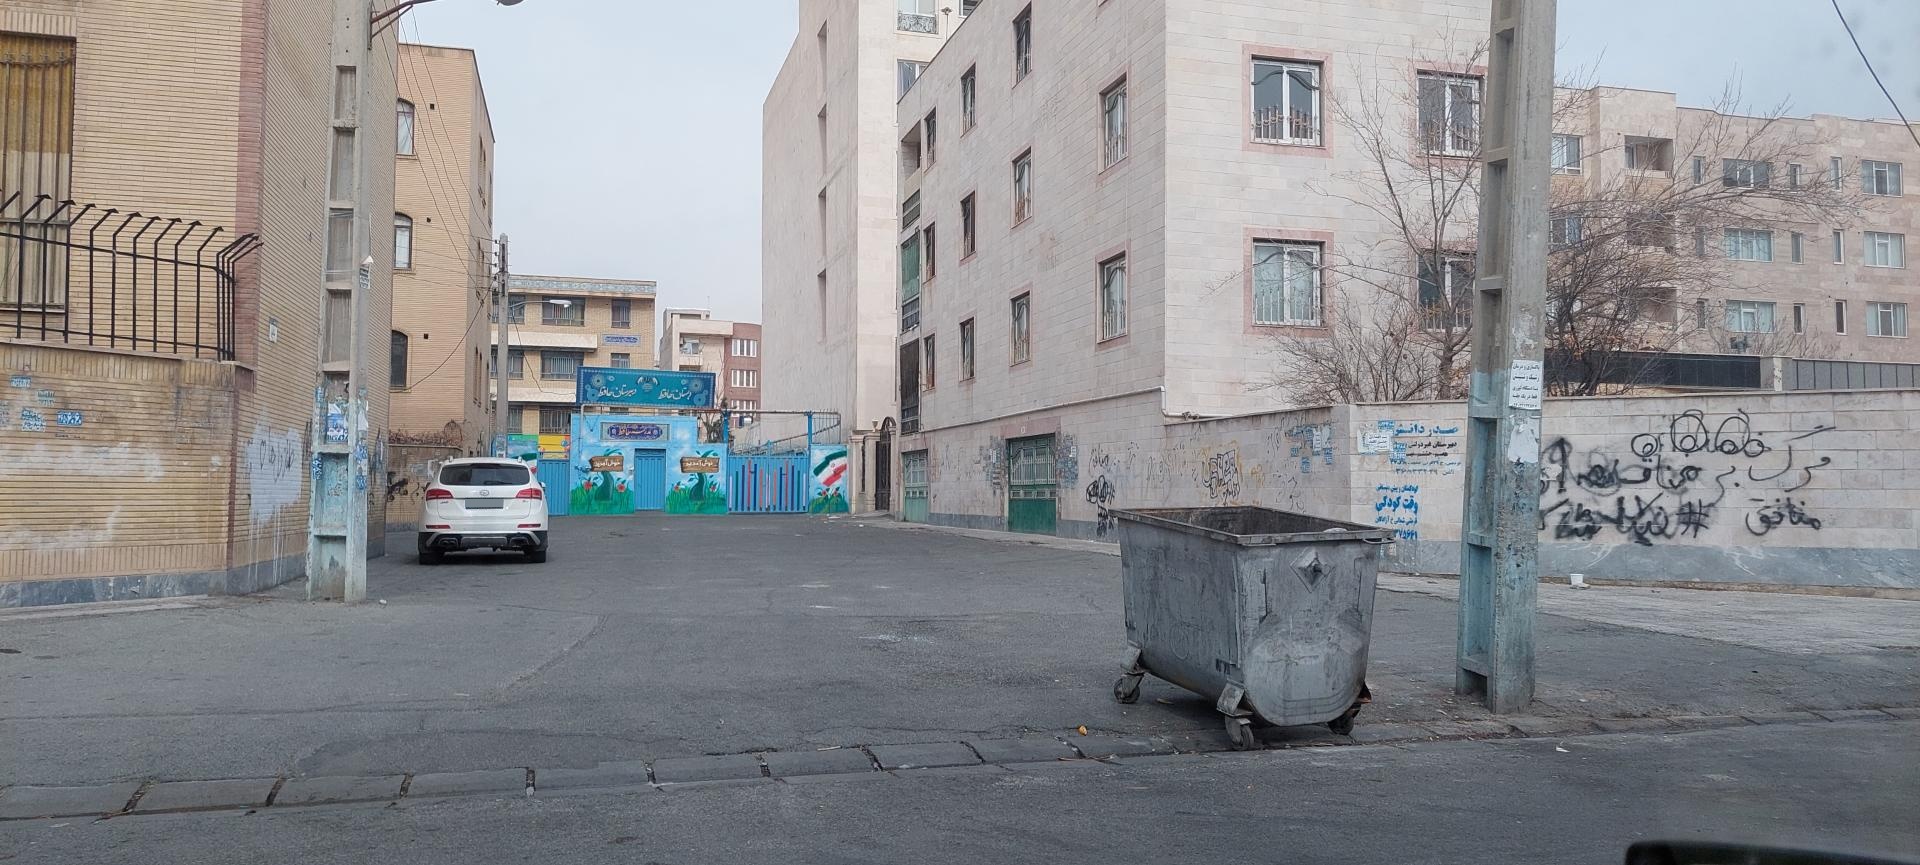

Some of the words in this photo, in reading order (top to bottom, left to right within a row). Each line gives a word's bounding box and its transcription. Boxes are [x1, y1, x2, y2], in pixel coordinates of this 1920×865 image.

[598, 385, 613, 397] حافظ
[612, 384, 637, 398] دبیرستان
[658, 389, 674, 399] حافظ
[671, 387, 692, 400] دبستان
[1432, 441, 1458, 449] دبیرستان
[1376, 495, 1401, 512] کودکی
[1403, 495, 1418, 514] وقت
[1745, 496, 1822, 537] منافق
